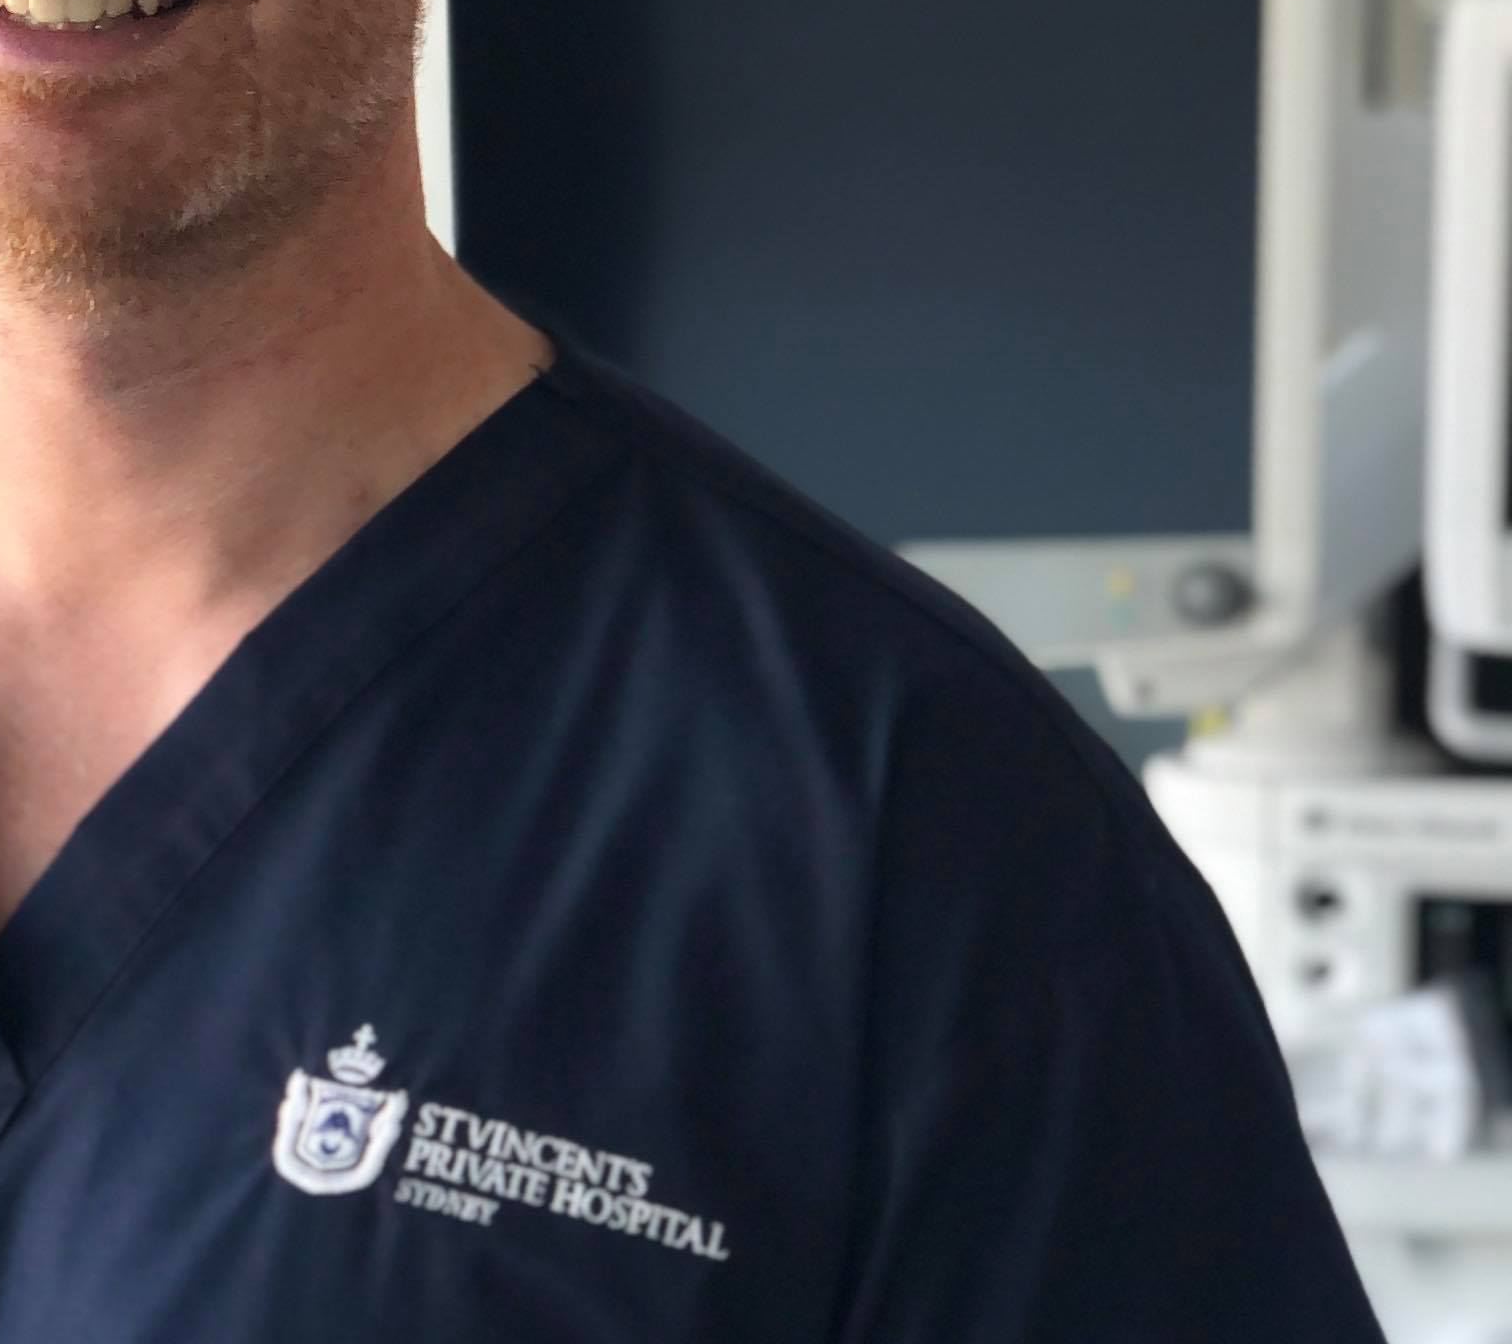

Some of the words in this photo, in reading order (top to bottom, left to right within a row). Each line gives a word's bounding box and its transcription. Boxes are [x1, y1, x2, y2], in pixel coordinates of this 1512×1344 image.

[394, 1178, 500, 1227] SYDNEY
[404, 1136, 550, 1207] PRIVATE
[549, 1177, 729, 1261] HOSPITAL
